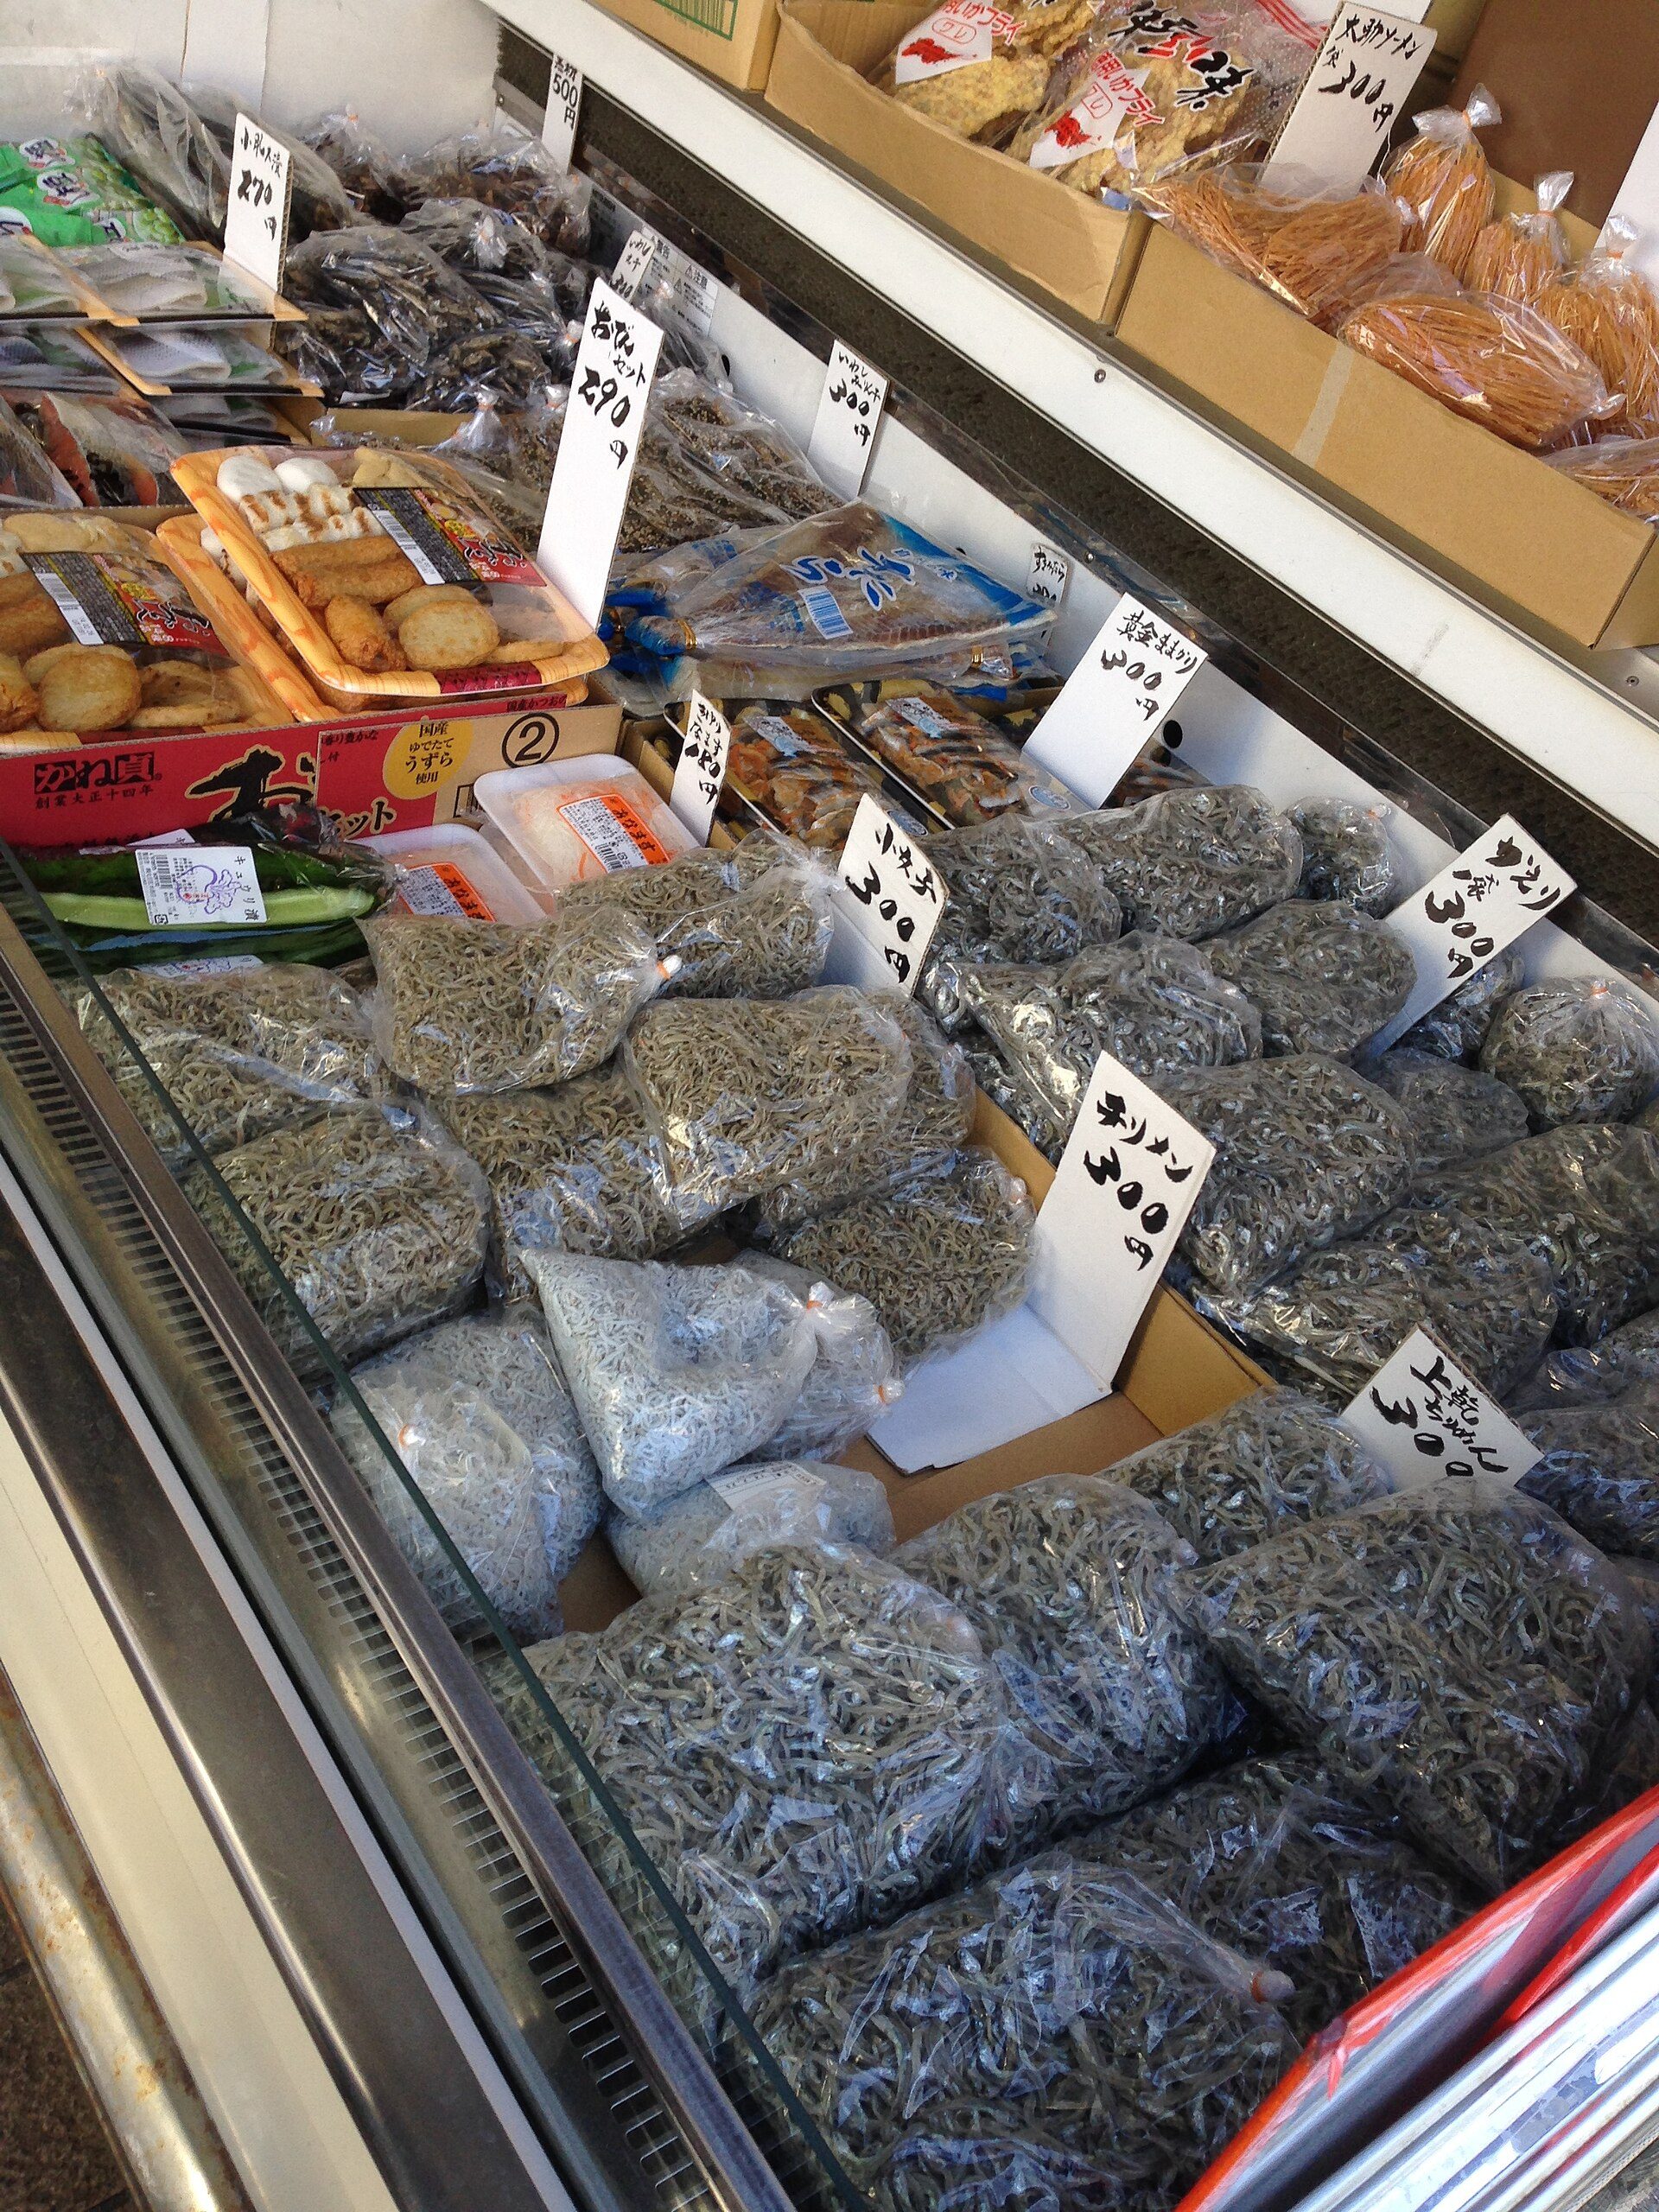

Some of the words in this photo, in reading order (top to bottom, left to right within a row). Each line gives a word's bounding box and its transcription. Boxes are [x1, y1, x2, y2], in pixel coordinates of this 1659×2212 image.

[552, 73, 578, 108] 500
[1318, 60, 1386, 105] 300
[563, 105, 576, 130] 円
[1372, 103, 1394, 133] 円
[238, 169, 273, 207] 270
[629, 238, 652, 257] いわし
[591, 301, 634, 357] おでん
[613, 354, 646, 387] セット
[838, 351, 868, 378] いわし
[578, 365, 631, 428] 290
[830, 378, 870, 416] 300
[854, 423, 871, 447] 円
[610, 439, 629, 470] 円
[1101, 650, 1162, 690] 300
[1135, 697, 1160, 721] 円
[410, 737, 454, 753] ゆでたて
[419, 721, 449, 738] 国産
[405, 752, 454, 774] うずら
[416, 771, 439, 785] 使用
[35, 785, 154, 810] 創業大正十四年
[699, 779, 718, 805] 円
[845, 861, 916, 943] 300
[1424, 890, 1495, 957] 300
[884, 945, 911, 983] 円
[1096, 1090, 1194, 1184] チリメン
[1084, 1146, 1170, 1235] 300
[1124, 1235, 1154, 1272] 円
[1370, 1386, 1474, 1477] 300
